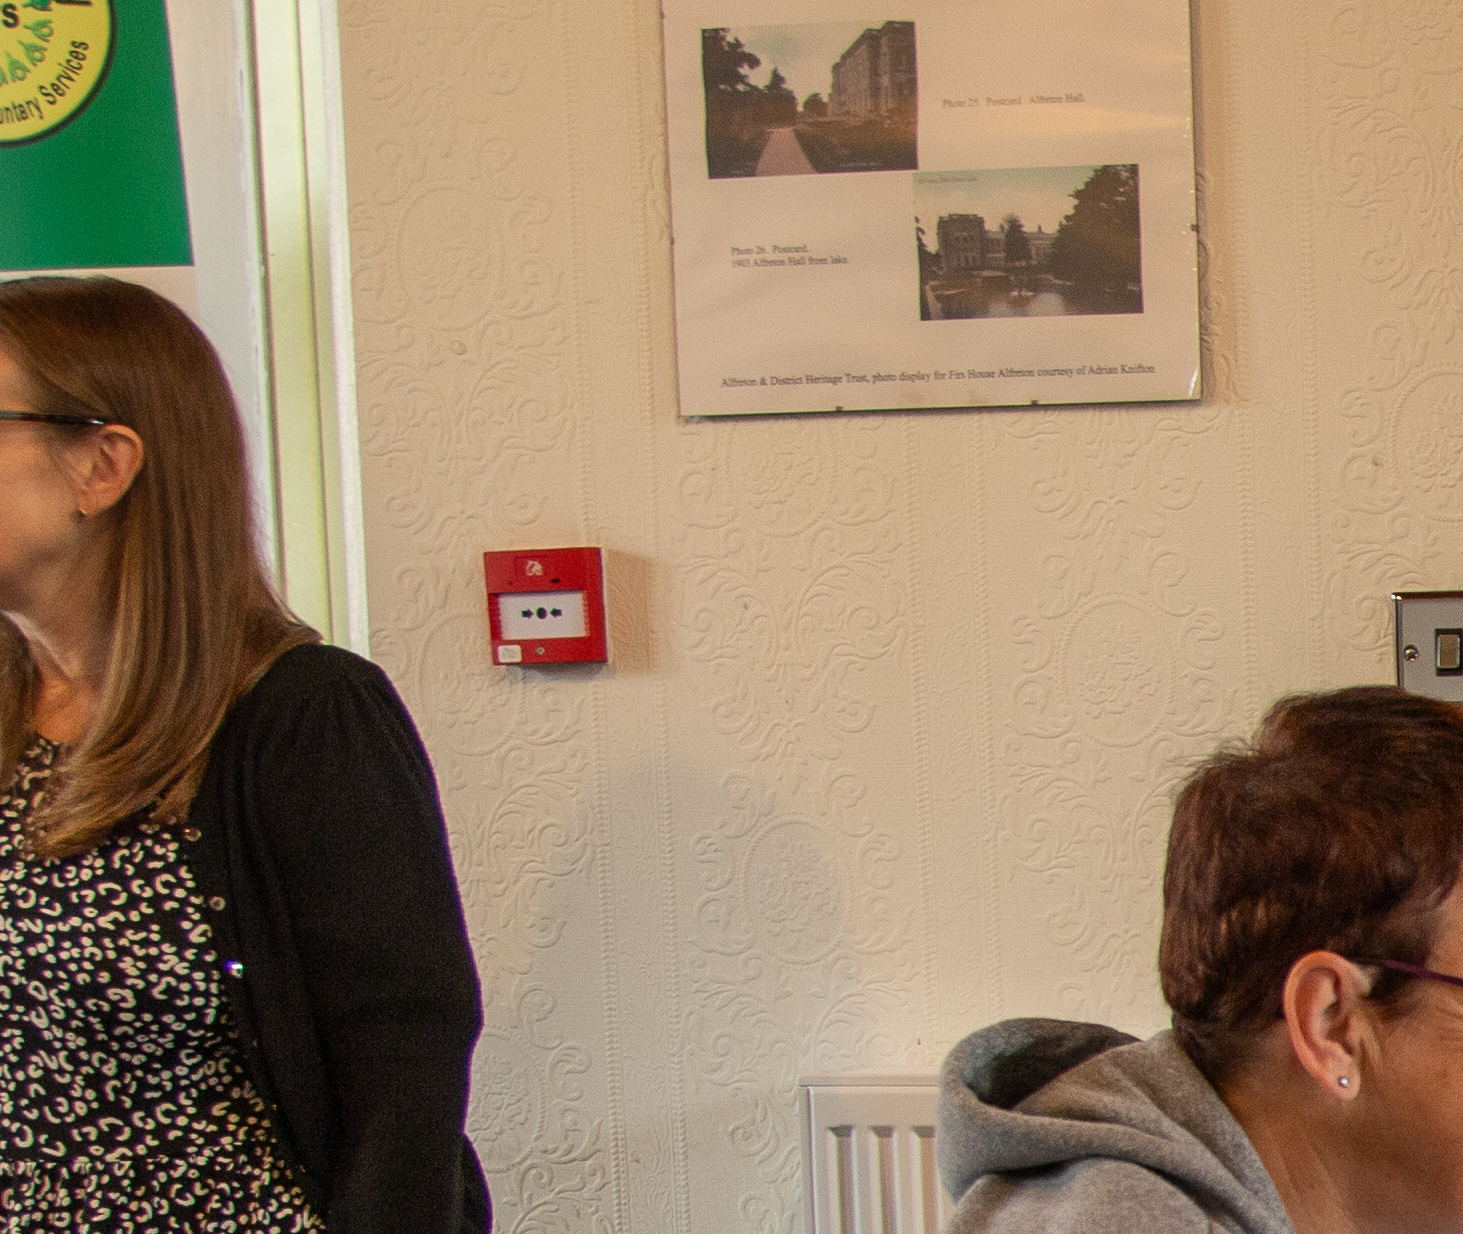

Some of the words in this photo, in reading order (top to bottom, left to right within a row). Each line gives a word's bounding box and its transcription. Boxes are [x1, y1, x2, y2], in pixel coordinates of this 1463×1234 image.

[37, 40, 90, 106] Services
[808, 255, 829, 265] from
[721, 377, 757, 388] Alfreton
[760, 376, 768, 386] &
[770, 375, 803, 386] District
[805, 374, 843, 387] Heritage
[872, 372, 896, 385] photo
[899, 371, 931, 384] display
[934, 370, 947, 380] for
[968, 369, 996, 379] House
[998, 367, 1035, 378] Alfreton
[1037, 367, 1074, 378] courtesy
[1076, 366, 1088, 376] of
[1088, 365, 1119, 375] Adrian
